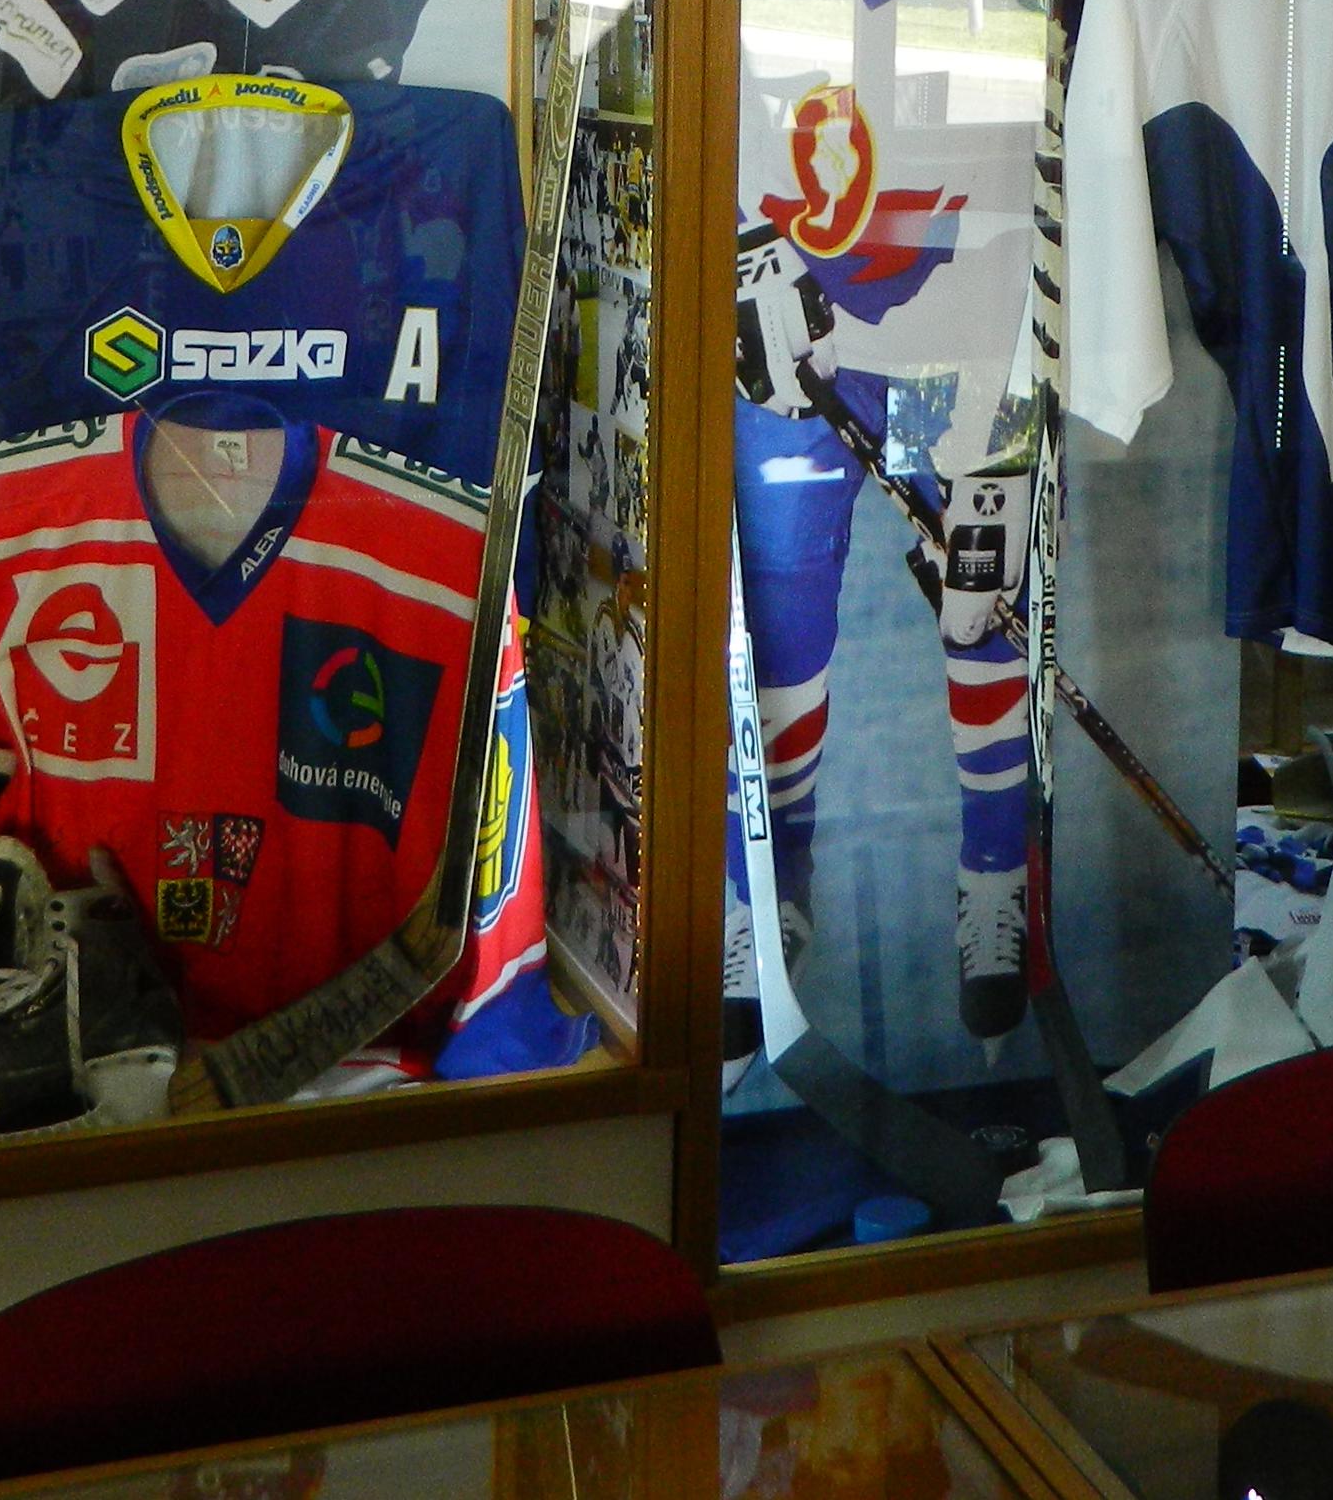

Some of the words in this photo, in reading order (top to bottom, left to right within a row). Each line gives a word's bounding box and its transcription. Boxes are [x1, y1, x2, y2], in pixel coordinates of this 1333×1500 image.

[235, 81, 309, 107] Tipsport
[383, 306, 440, 403] A
[239, 525, 285, 583] ALEA
